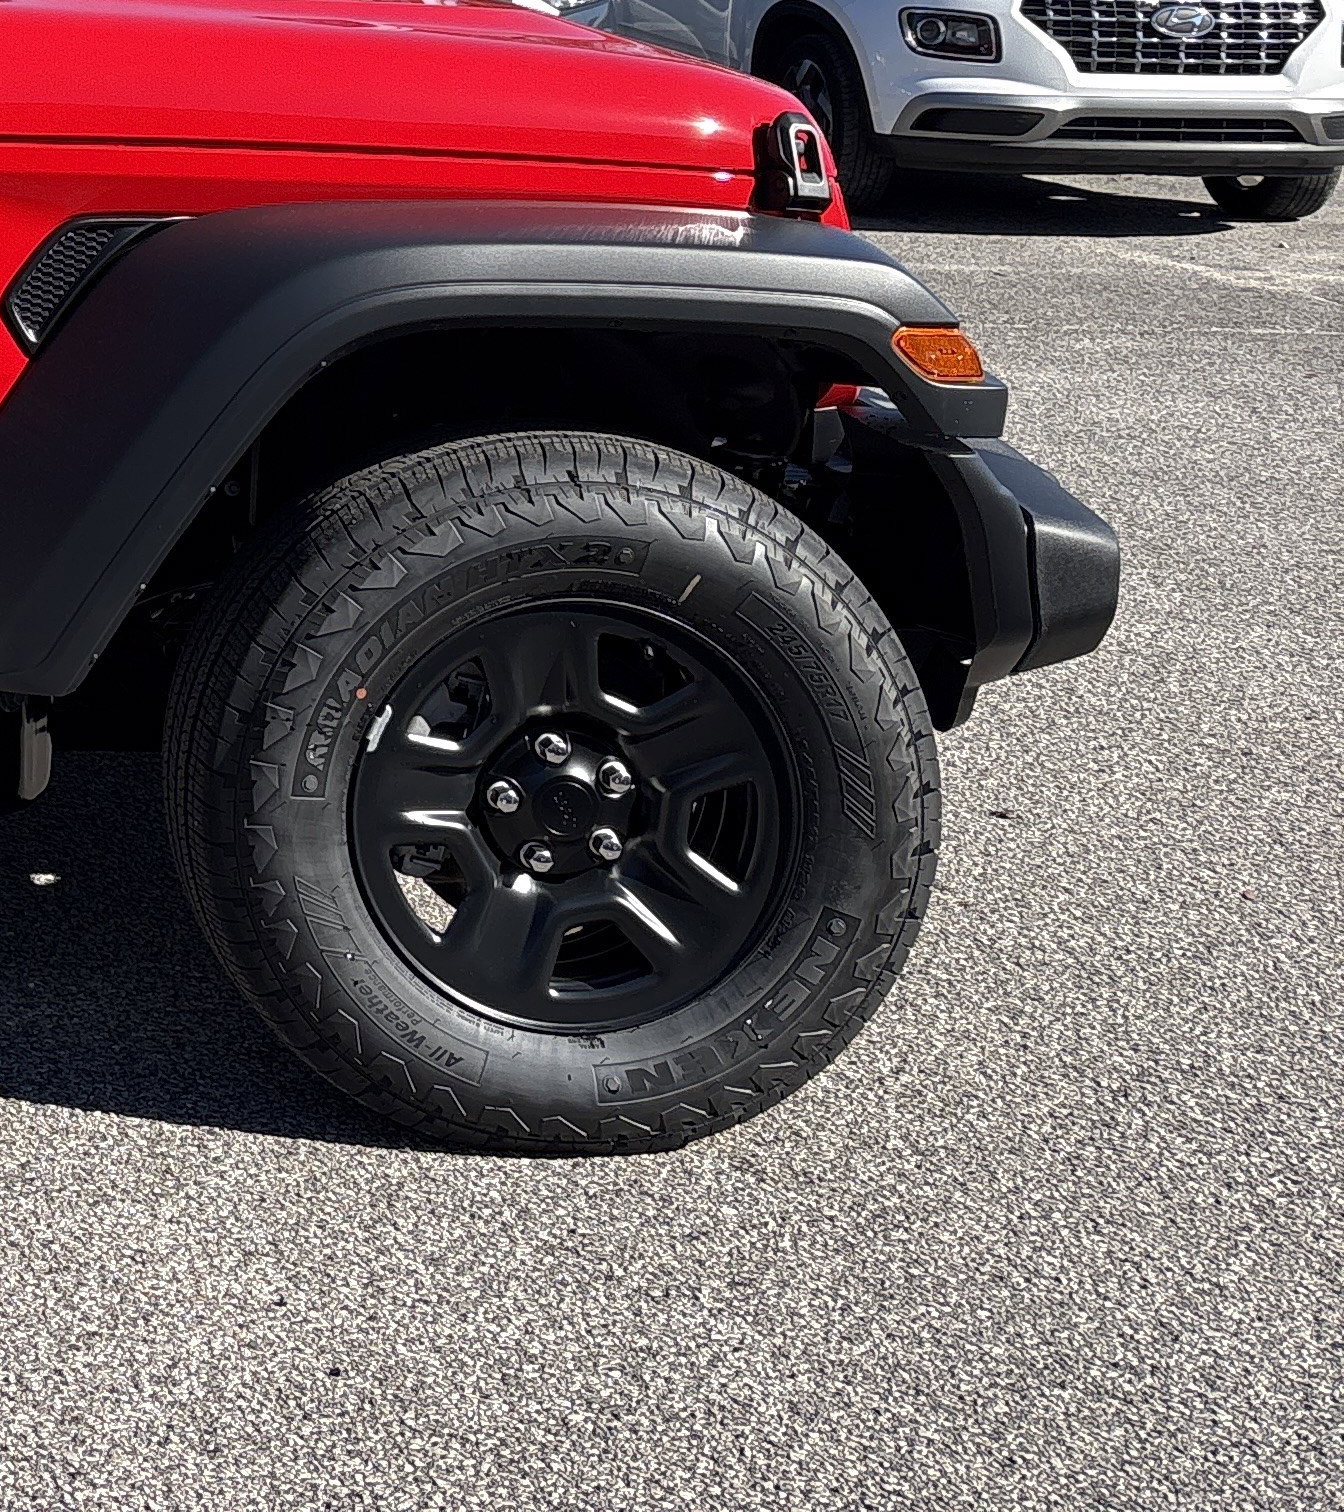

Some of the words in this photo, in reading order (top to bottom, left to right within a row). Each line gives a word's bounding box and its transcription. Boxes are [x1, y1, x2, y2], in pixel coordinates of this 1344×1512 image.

[767, 623, 849, 721] 245/75R17
[351, 978, 464, 1067] All-Weather
[364, 968, 423, 1026] Performance
[625, 936, 841, 1093] NEXEN
